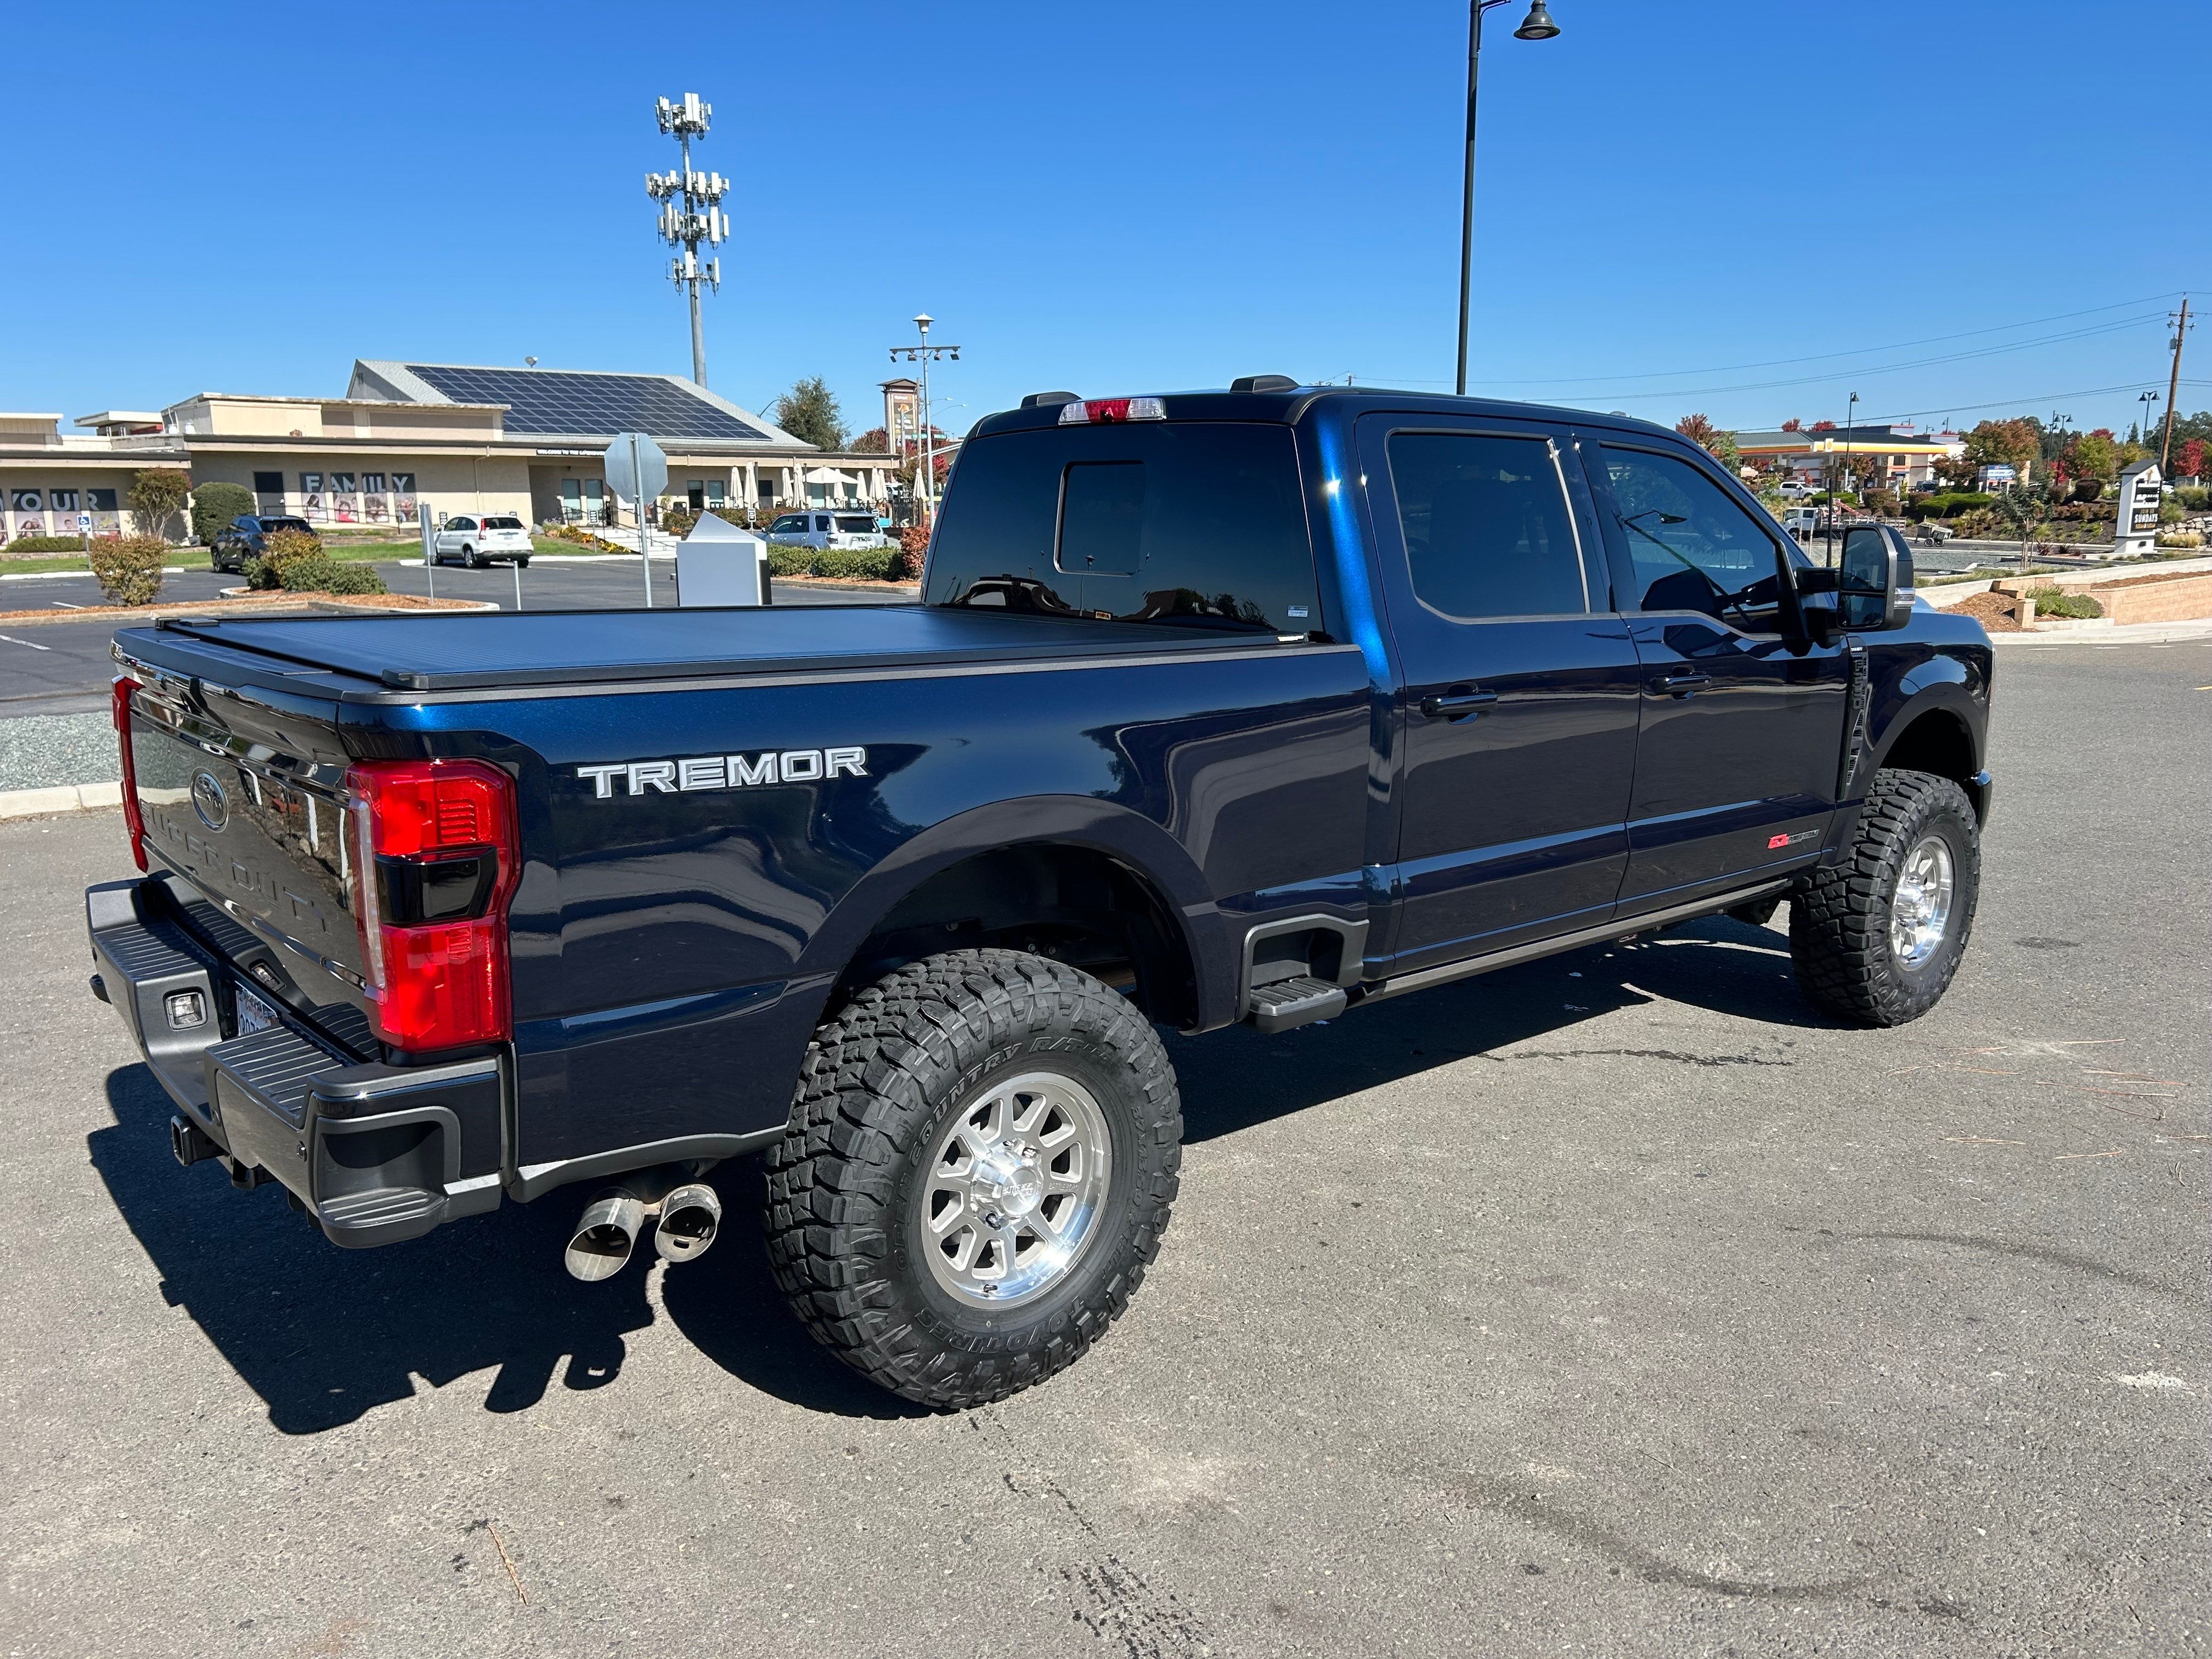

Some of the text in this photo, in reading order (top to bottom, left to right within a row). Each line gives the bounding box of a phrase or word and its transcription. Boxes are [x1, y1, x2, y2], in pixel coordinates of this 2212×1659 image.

[306, 475, 408, 493] FAMILY
[2134, 514, 2158, 523] SUNDAYS
[577, 746, 870, 799] TREMOR
[139, 798, 340, 936] SUPER DUTY
[894, 1171, 913, 1272] OPEN
[910, 1042, 1023, 1167] COUNTRY
[1029, 1036, 1085, 1053] R/T
[914, 1295, 1085, 1354] TOYO TIRES
